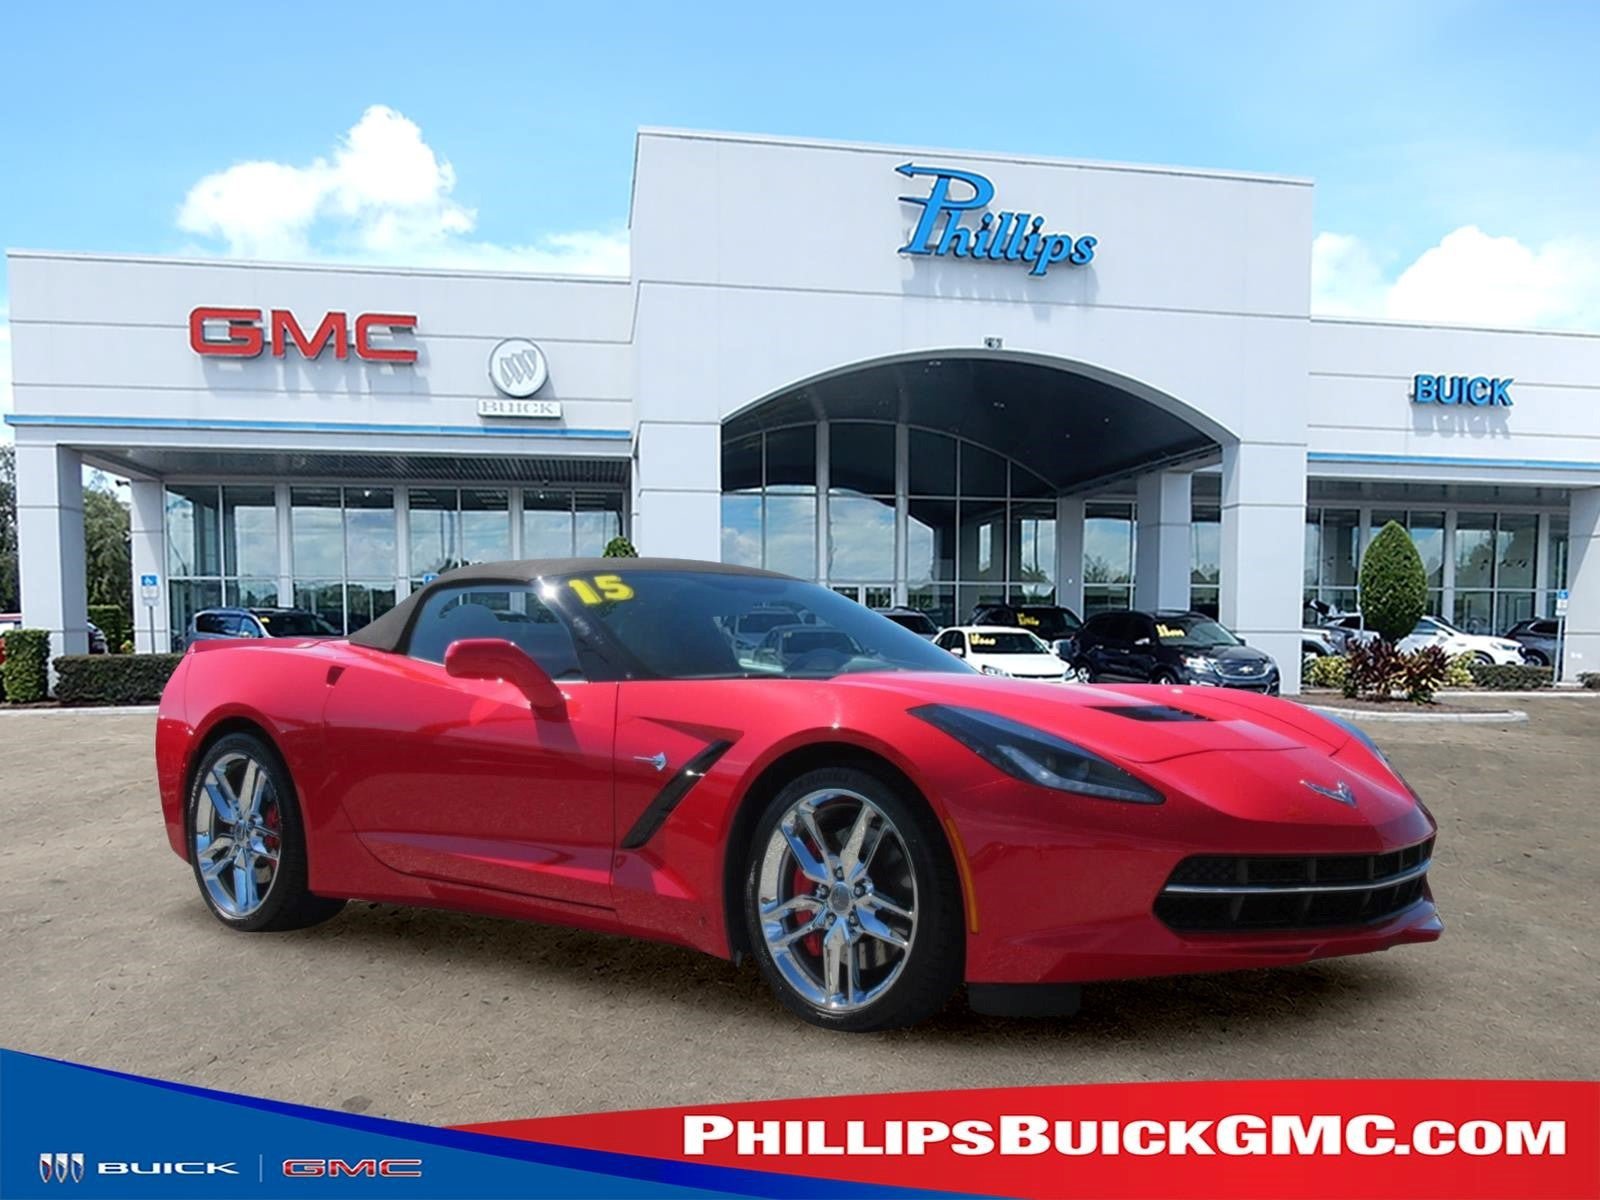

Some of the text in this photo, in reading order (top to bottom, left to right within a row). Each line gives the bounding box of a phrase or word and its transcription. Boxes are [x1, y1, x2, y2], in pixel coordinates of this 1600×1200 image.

[895, 162, 1098, 276] Phillips
[188, 306, 419, 364] GMC
[1413, 373, 1514, 407] BUICK
[481, 400, 554, 415] BUICK
[567, 574, 635, 605] 15
